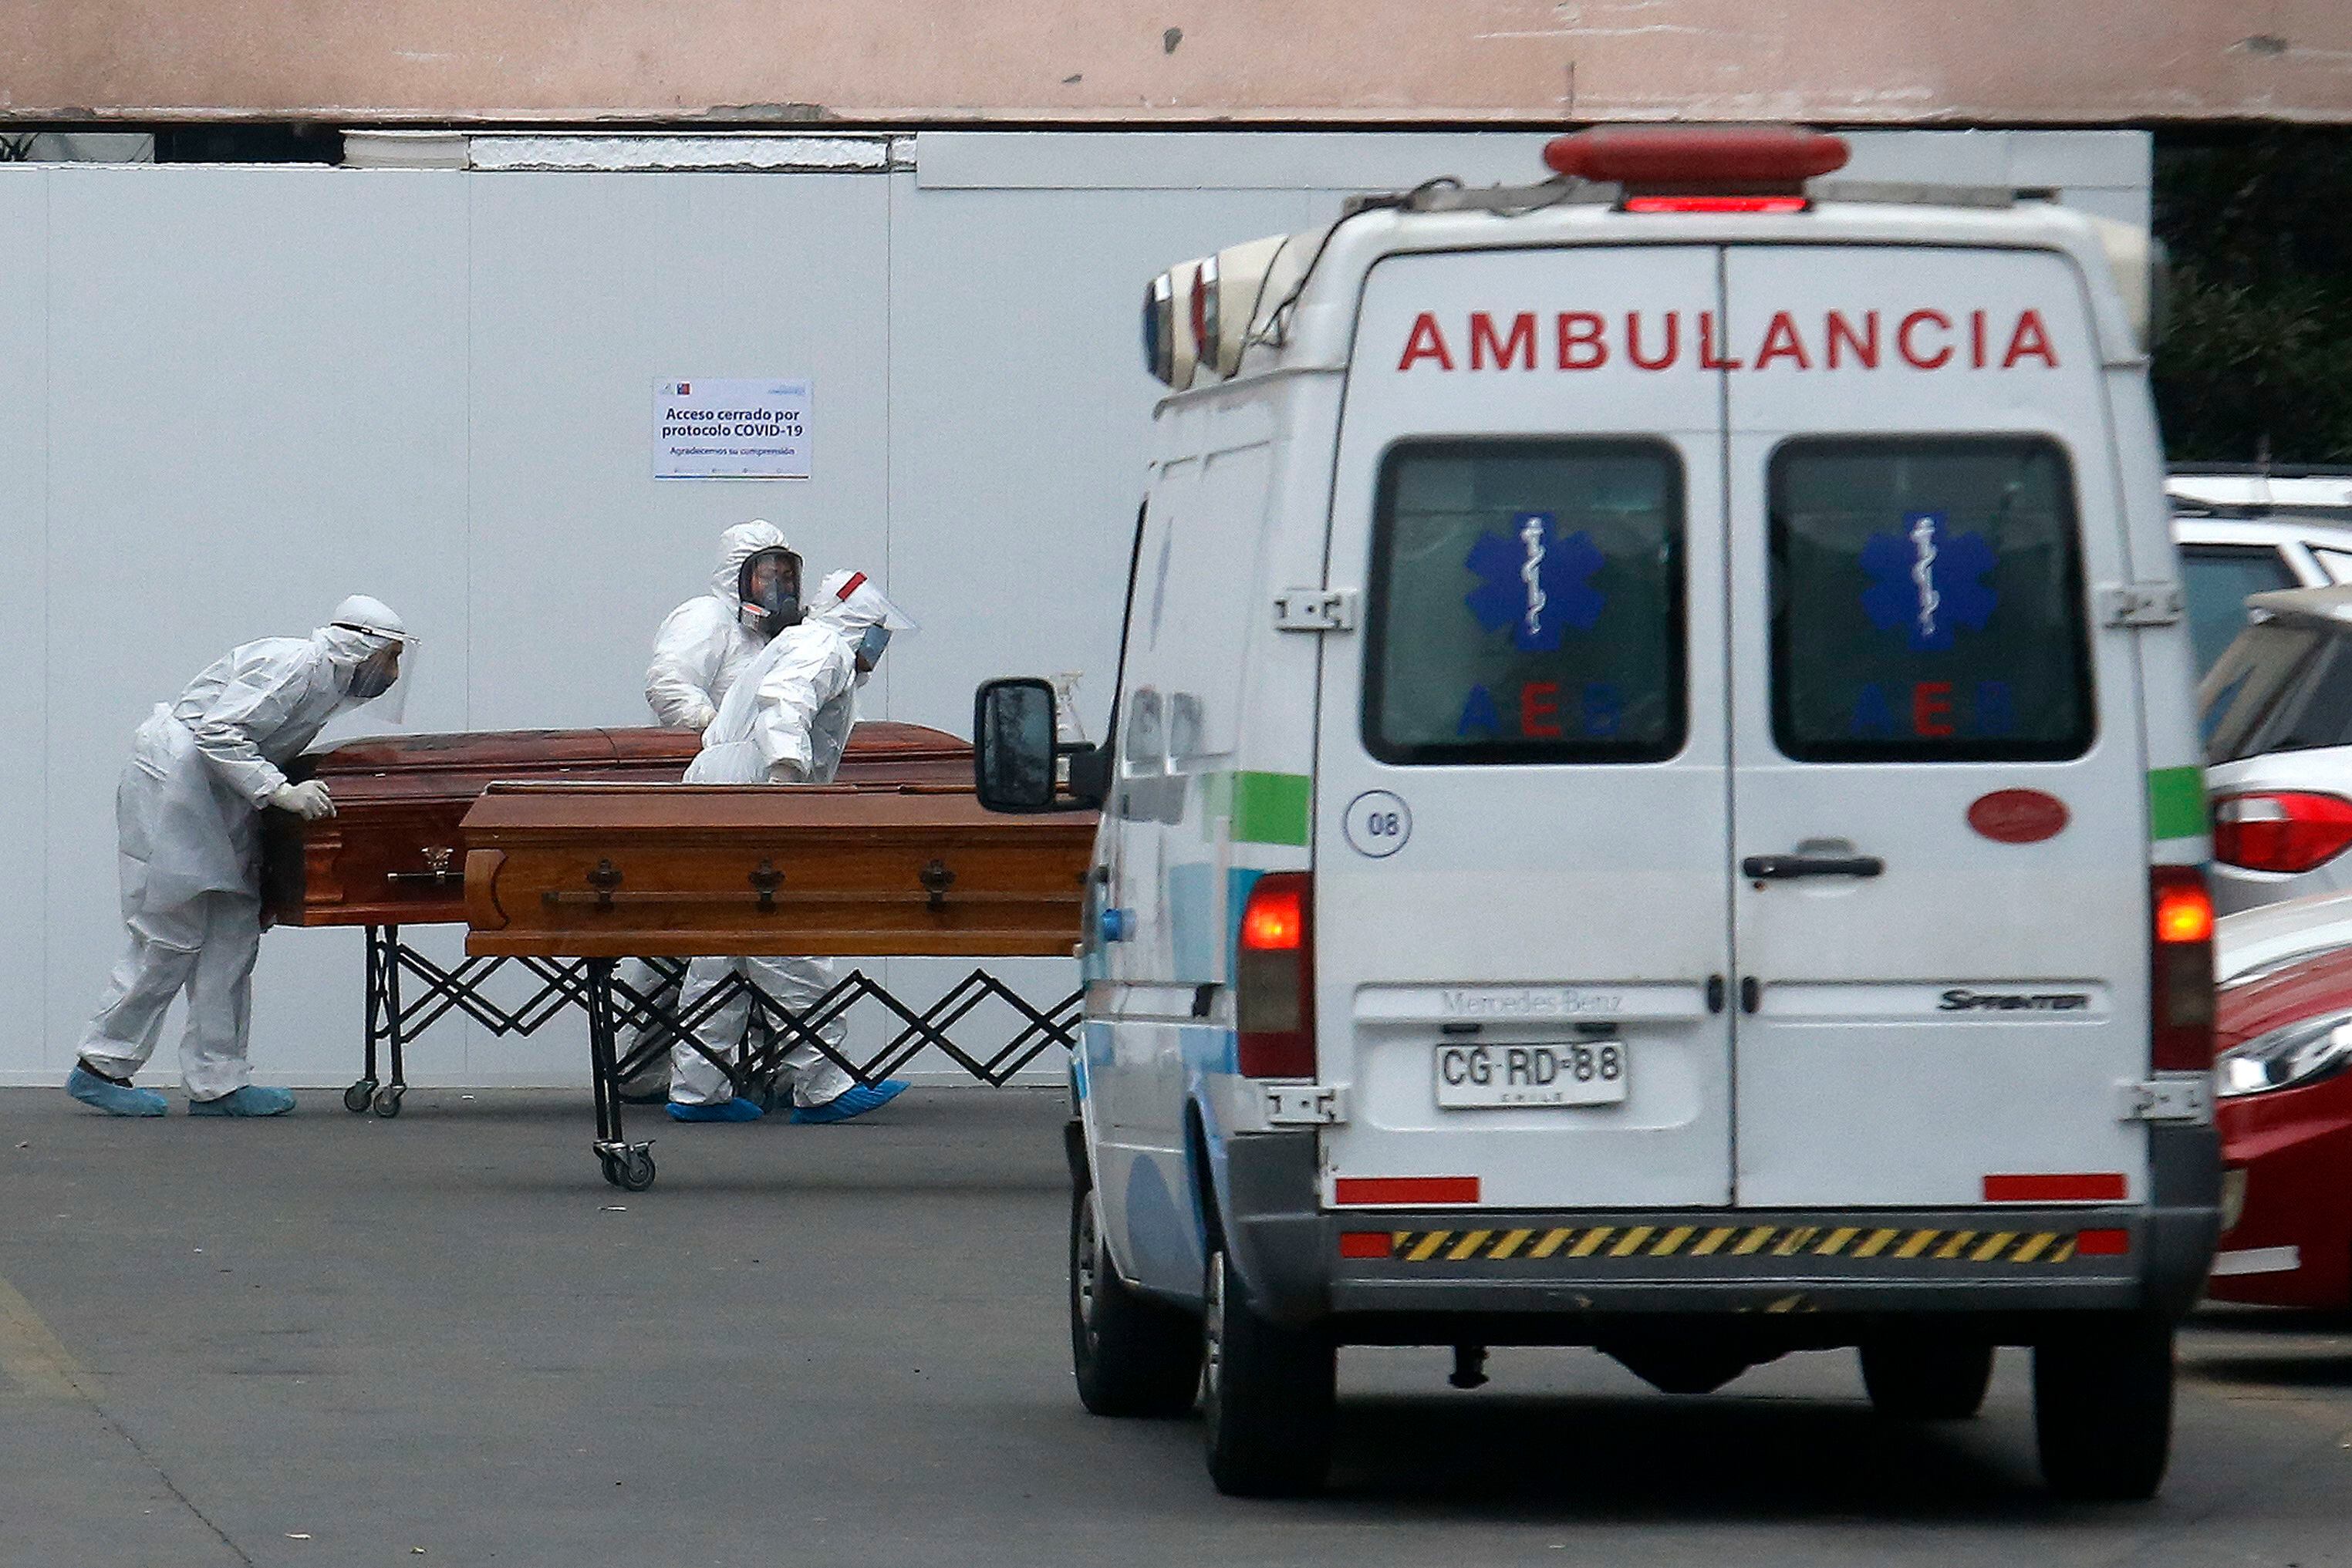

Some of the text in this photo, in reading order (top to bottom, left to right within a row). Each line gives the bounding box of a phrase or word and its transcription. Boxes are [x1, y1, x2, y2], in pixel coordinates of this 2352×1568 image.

[1398, 309, 2060, 371] AMBULANCIA
[666, 408, 800, 423] Acceso cerrado por
[662, 424, 802, 438] protocolo COVID-19
[670, 447, 727, 457] Agradecemos
[1368, 812, 1399, 835] 08
[1501, 1092, 1563, 1102] CHILE
